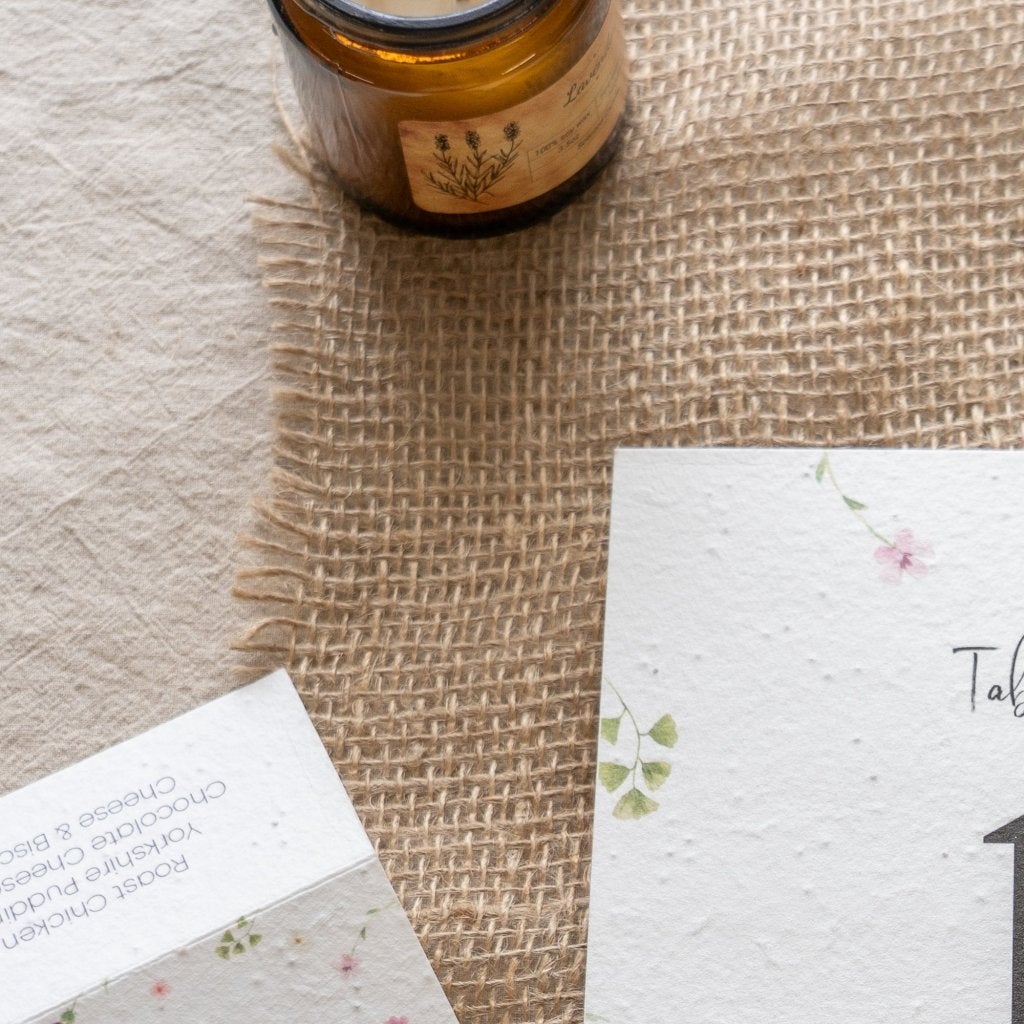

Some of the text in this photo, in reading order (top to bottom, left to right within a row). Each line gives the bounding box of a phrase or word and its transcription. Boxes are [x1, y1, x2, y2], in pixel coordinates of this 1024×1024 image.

[0, 780, 227, 894] Chocolate Chees
[54, 822, 73, 841] &
[78, 776, 176, 829] Cheese
[0, 822, 203, 925] Yorkshire Puddi
[1, 854, 190, 950] Roast Chicken
